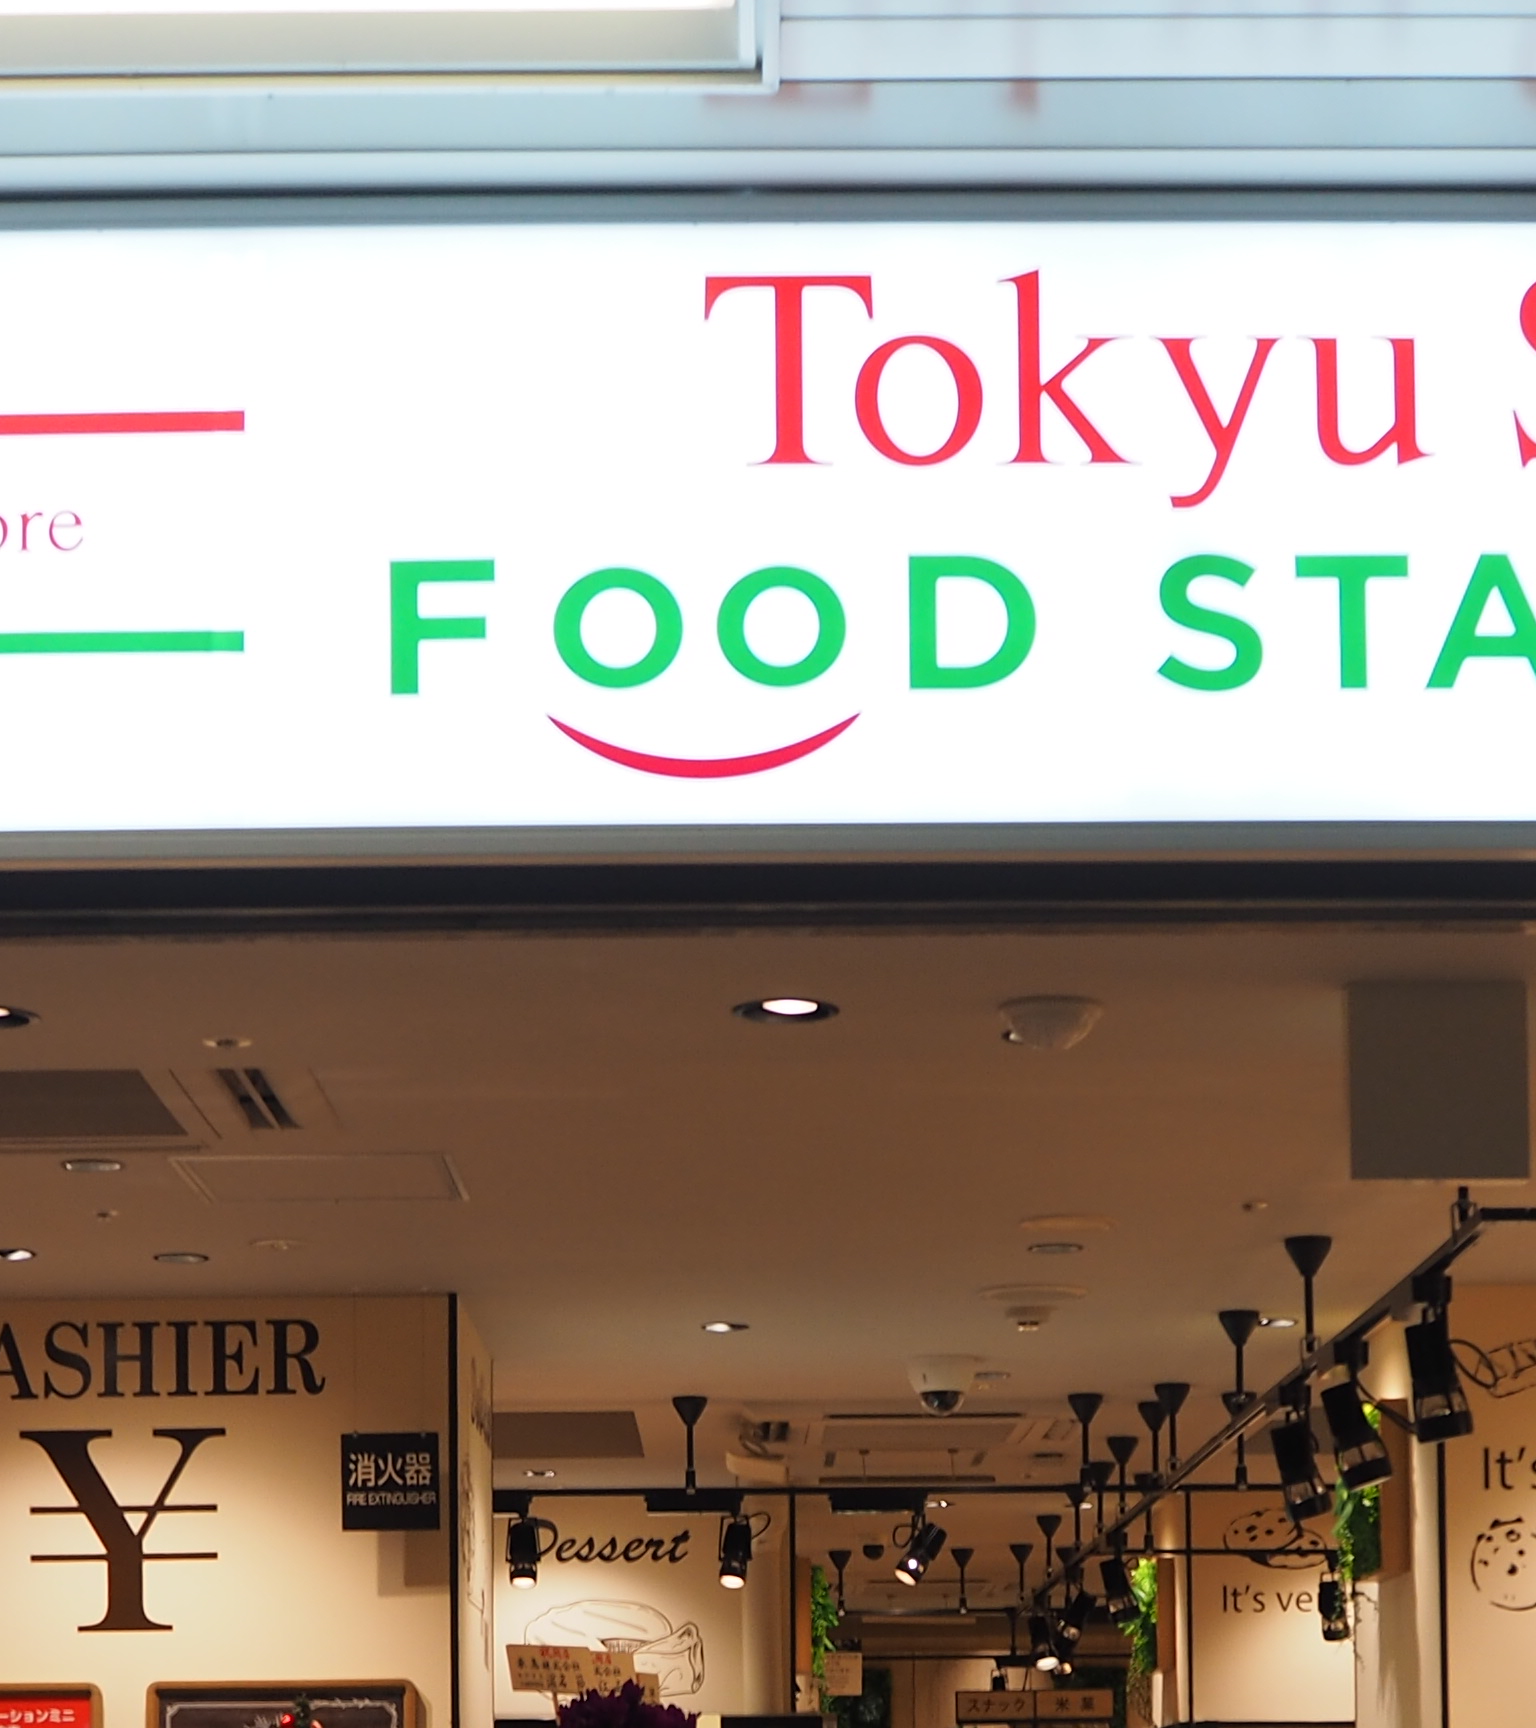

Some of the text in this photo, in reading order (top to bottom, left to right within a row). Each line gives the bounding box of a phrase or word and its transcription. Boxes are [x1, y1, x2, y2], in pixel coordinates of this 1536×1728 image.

[705, 270, 1432, 509] Tokyu
[390, 555, 1038, 697] FOOD
[348, 1452, 433, 1488] 消火器
[536, 1517, 691, 1564] Dessert
[966, 1699, 1026, 1714] スナック
